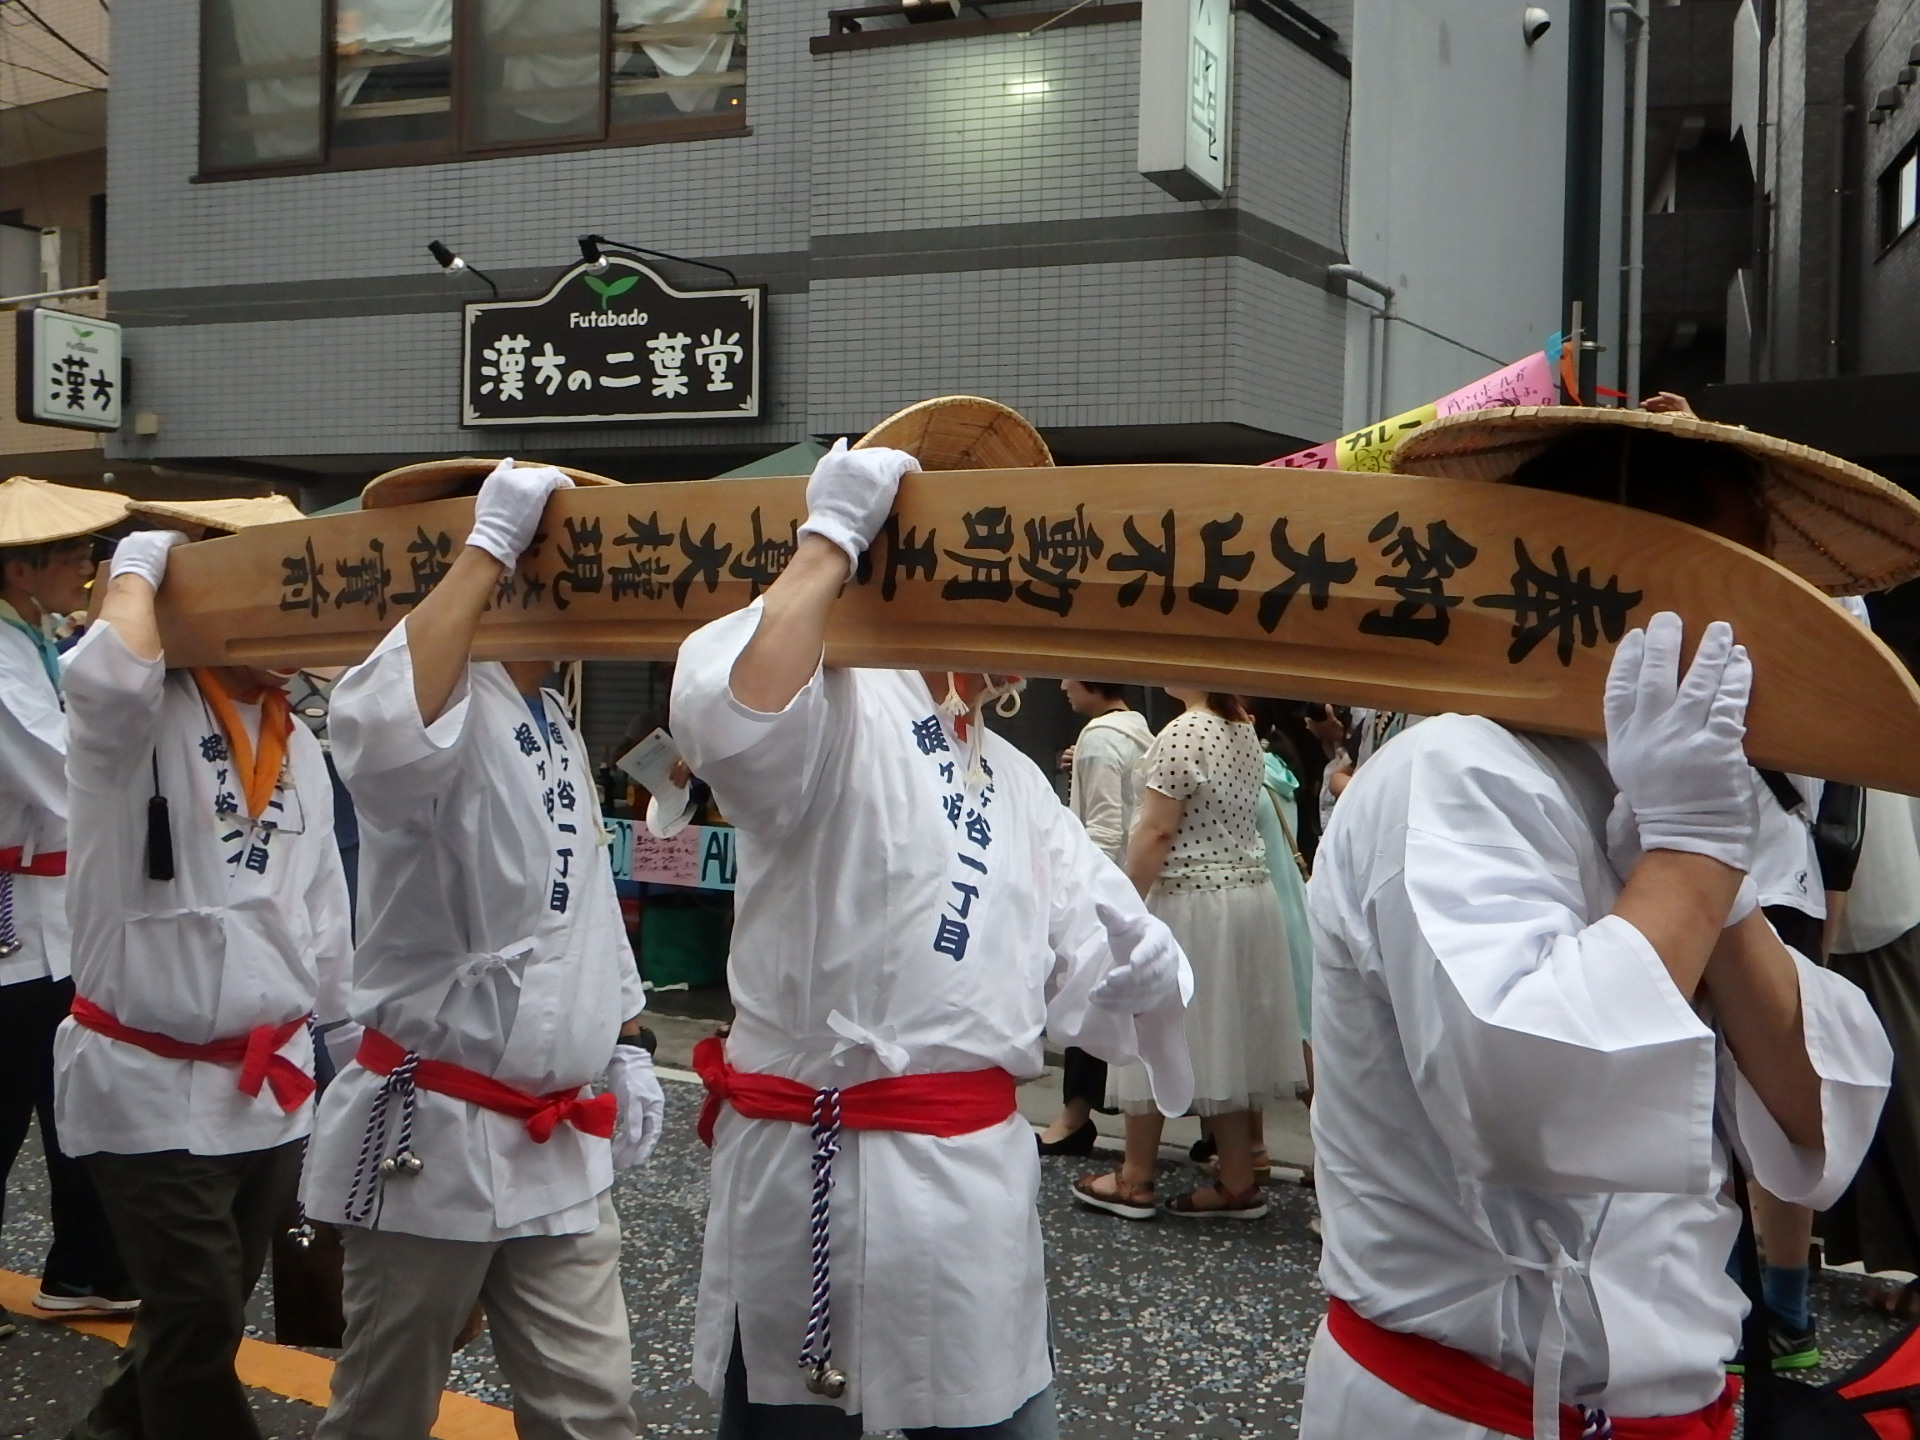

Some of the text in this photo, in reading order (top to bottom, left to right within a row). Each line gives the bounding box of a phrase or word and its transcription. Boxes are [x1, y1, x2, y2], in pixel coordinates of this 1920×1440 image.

[570, 309, 648, 328] Futabado
[50, 354, 114, 412] 漢方
[480, 329, 744, 401] 漢方の二葉堂
[1345, 420, 1423, 451] カレー
